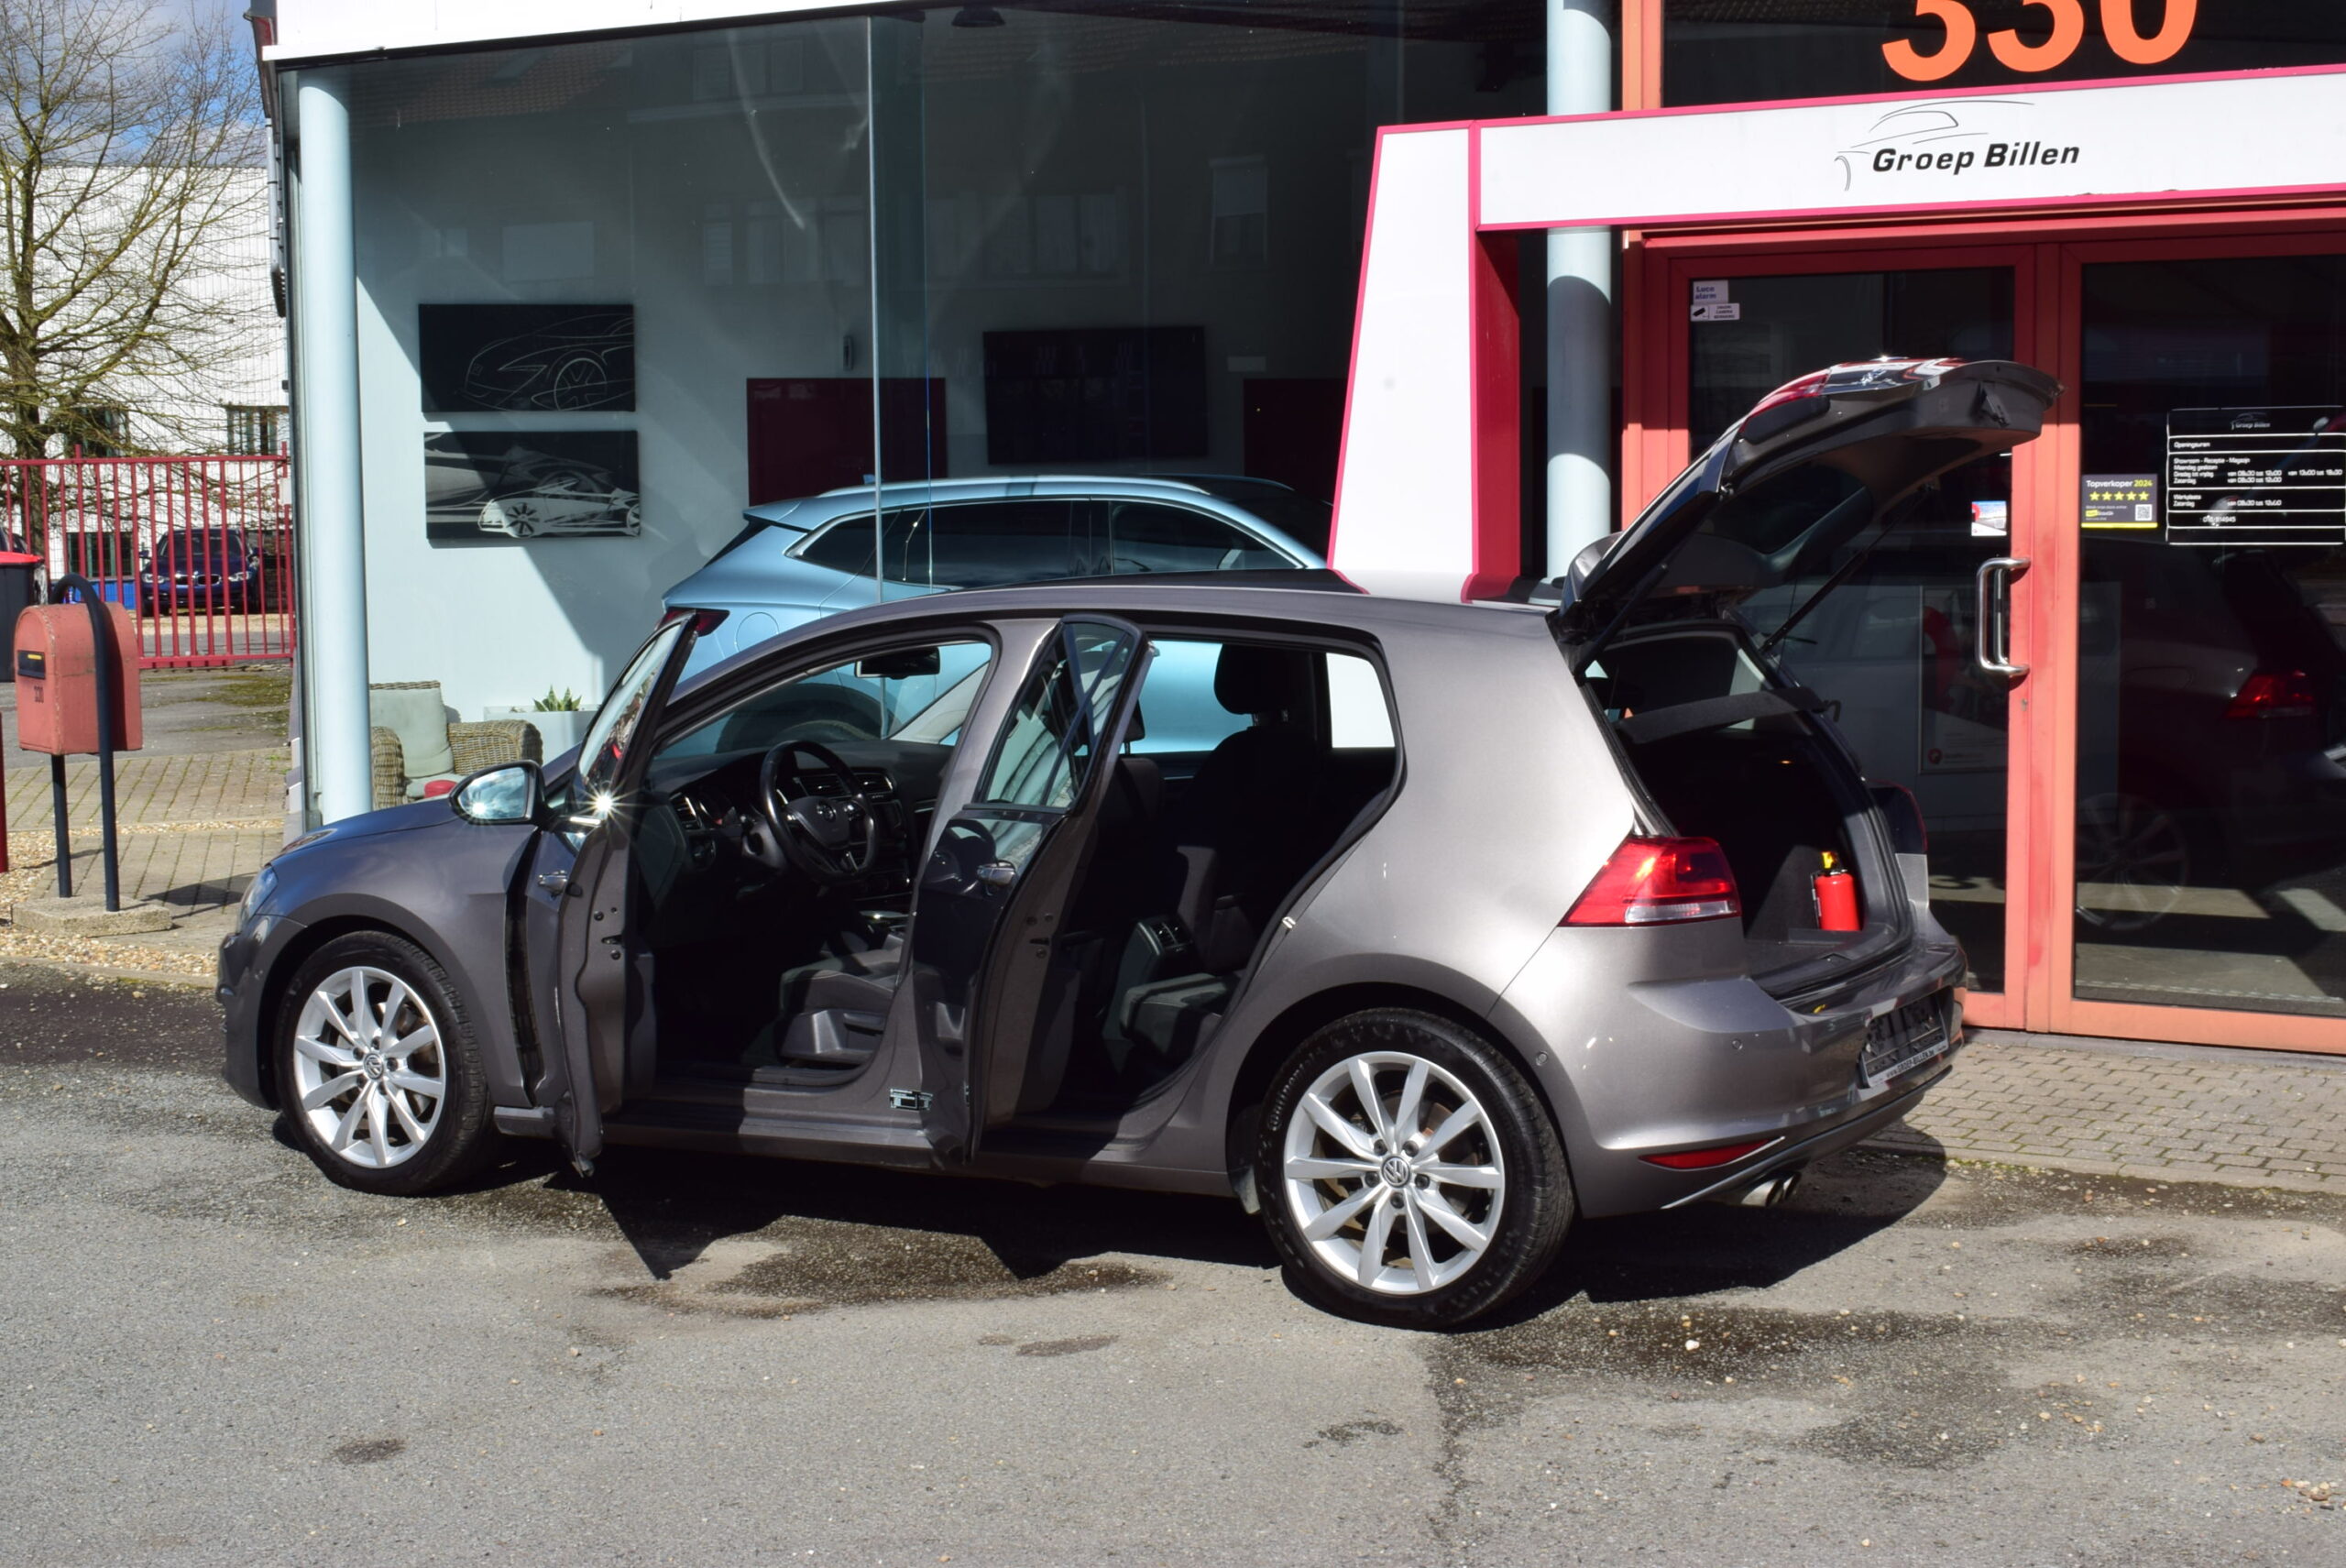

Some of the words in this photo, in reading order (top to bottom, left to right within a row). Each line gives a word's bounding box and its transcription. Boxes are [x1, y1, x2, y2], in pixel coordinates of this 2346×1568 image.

[1872, 148, 1975, 175] Groep
[1984, 141, 2080, 168] Billen
[2174, 441, 2210, 449] Openingsuren
[2086, 479, 2133, 488] Topverkoper
